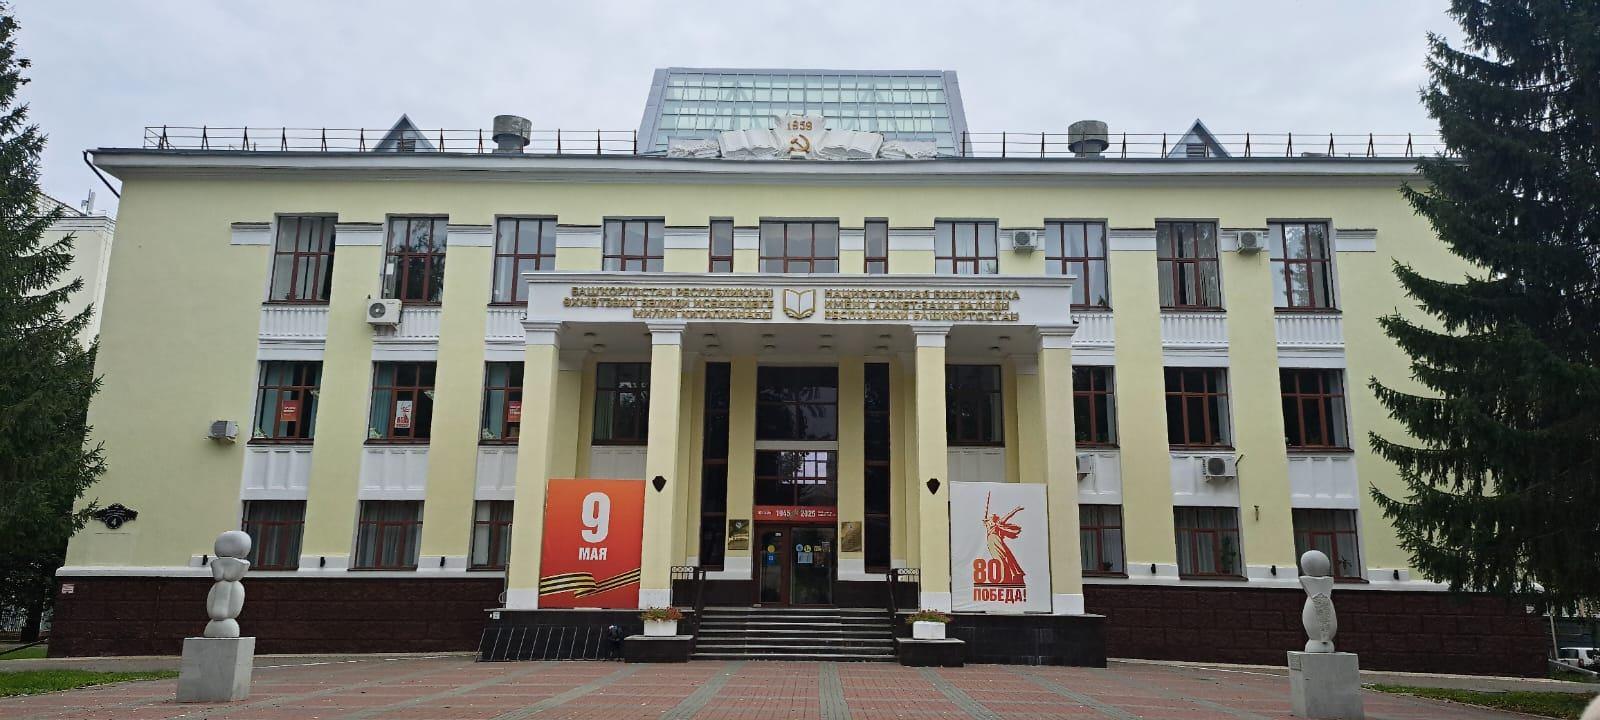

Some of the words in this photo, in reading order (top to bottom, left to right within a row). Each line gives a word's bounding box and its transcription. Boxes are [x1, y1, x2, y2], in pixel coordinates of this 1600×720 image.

[825, 289, 930, 300] НАЦИОНАЛЬНАЯ
[934, 290, 1020, 300] БИБЛИОТЕКА
[825, 299, 869, 310] ИМЕНИ
[959, 301, 1010, 311] ВАЛИДИ
[632, 309, 677, 319] МИЛЛИ
[825, 310, 909, 321] РЕСПУБЛИКИ
[912, 312, 1020, 322] БАШКОРТОСТАН
[581, 491, 611, 544] 9
[775, 509, 791, 518] 1945
[578, 547, 608, 561] МАЯ
[973, 558, 1002, 584] 80
[973, 588, 1027, 604] ПОБЕДА!
